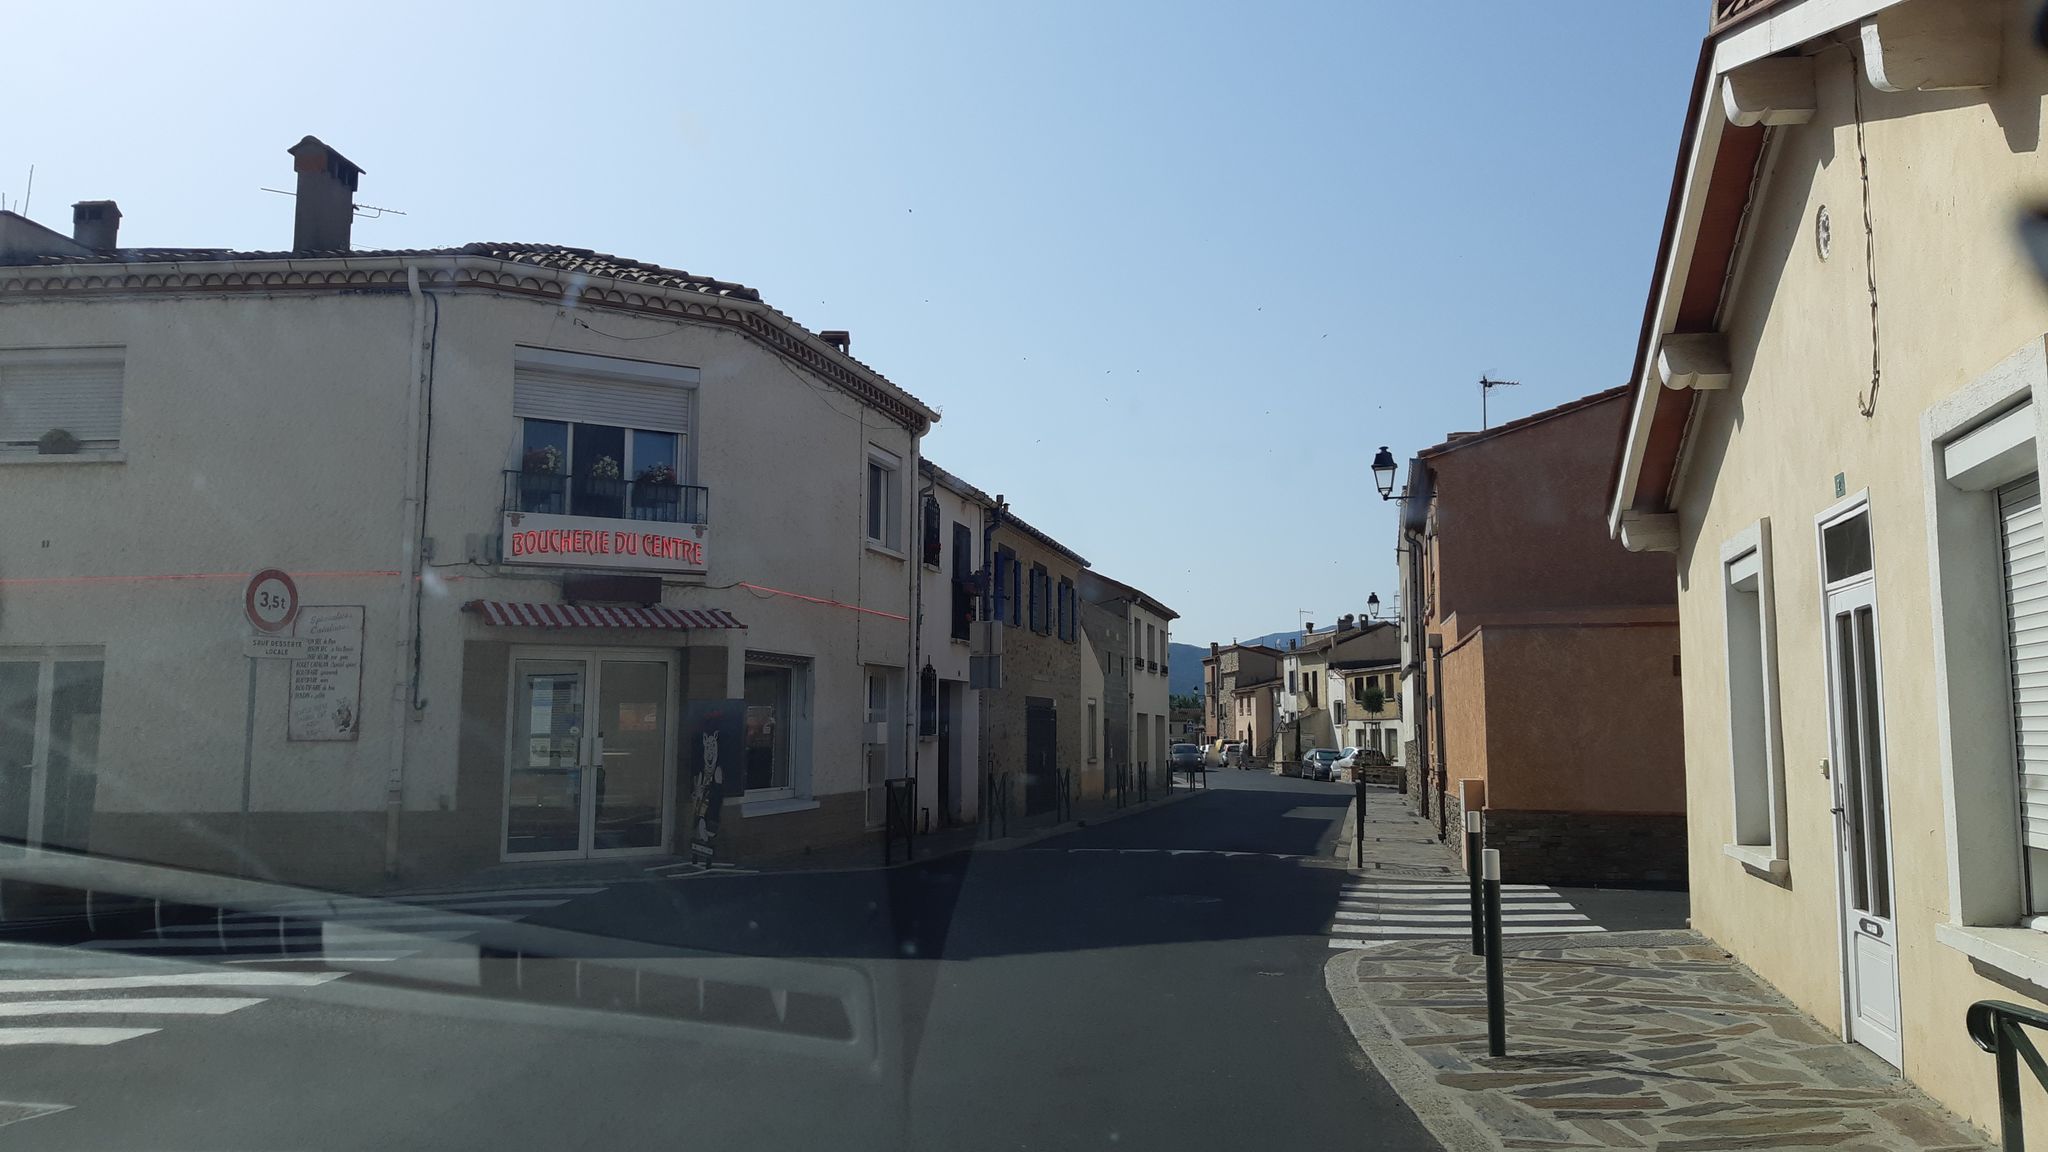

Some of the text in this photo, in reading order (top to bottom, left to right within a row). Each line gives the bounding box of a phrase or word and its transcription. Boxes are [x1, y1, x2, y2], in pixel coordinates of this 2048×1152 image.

[512, 529, 704, 566] BOUCHERIE DU CENTRE
[260, 591, 286, 610] 3,5t
[252, 639, 269, 647] SAUF
[270, 640, 303, 648] DESSERTE
[265, 648, 288, 656] LOCALE
